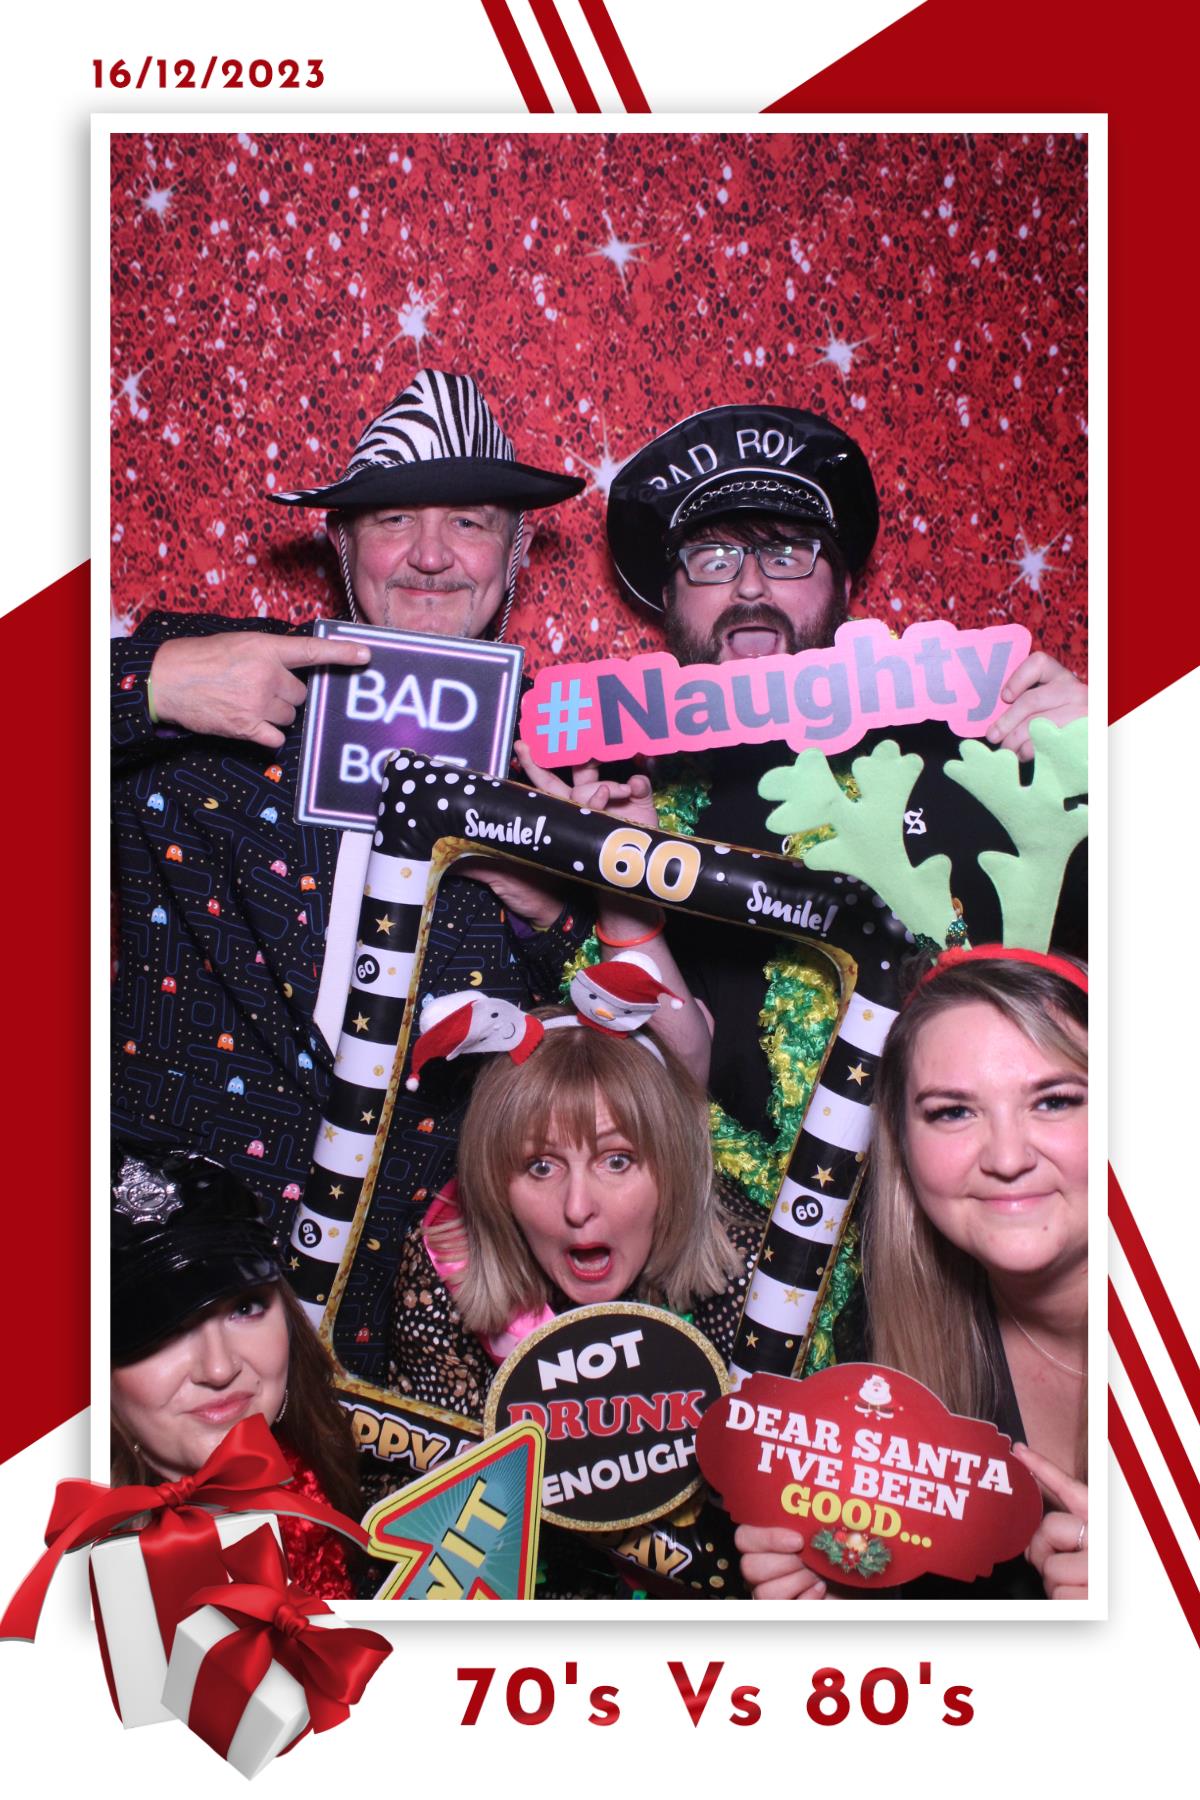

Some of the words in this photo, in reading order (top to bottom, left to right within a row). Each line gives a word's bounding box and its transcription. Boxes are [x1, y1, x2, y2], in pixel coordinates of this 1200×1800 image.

[346, 669, 477, 732] BAD
[537, 637, 1013, 753] #Naughty
[464, 808, 547, 851] Smile!
[599, 827, 701, 902] 60
[746, 880, 839, 937] Smile!
[357, 960, 376, 979] 60
[302, 1222, 317, 1245] 60
[796, 1202, 818, 1221] 60
[538, 1330, 643, 1391] NOT
[338, 1401, 450, 1473] PPY
[507, 1390, 707, 1440] DRUNK
[725, 1398, 842, 1454] DEAR
[852, 1429, 1013, 1495] SANTA
[542, 1435, 697, 1507] ENOUGH
[757, 1442, 843, 1490] I'VE
[851, 1464, 970, 1520] BEEN
[780, 1483, 932, 1549] GOOD...
